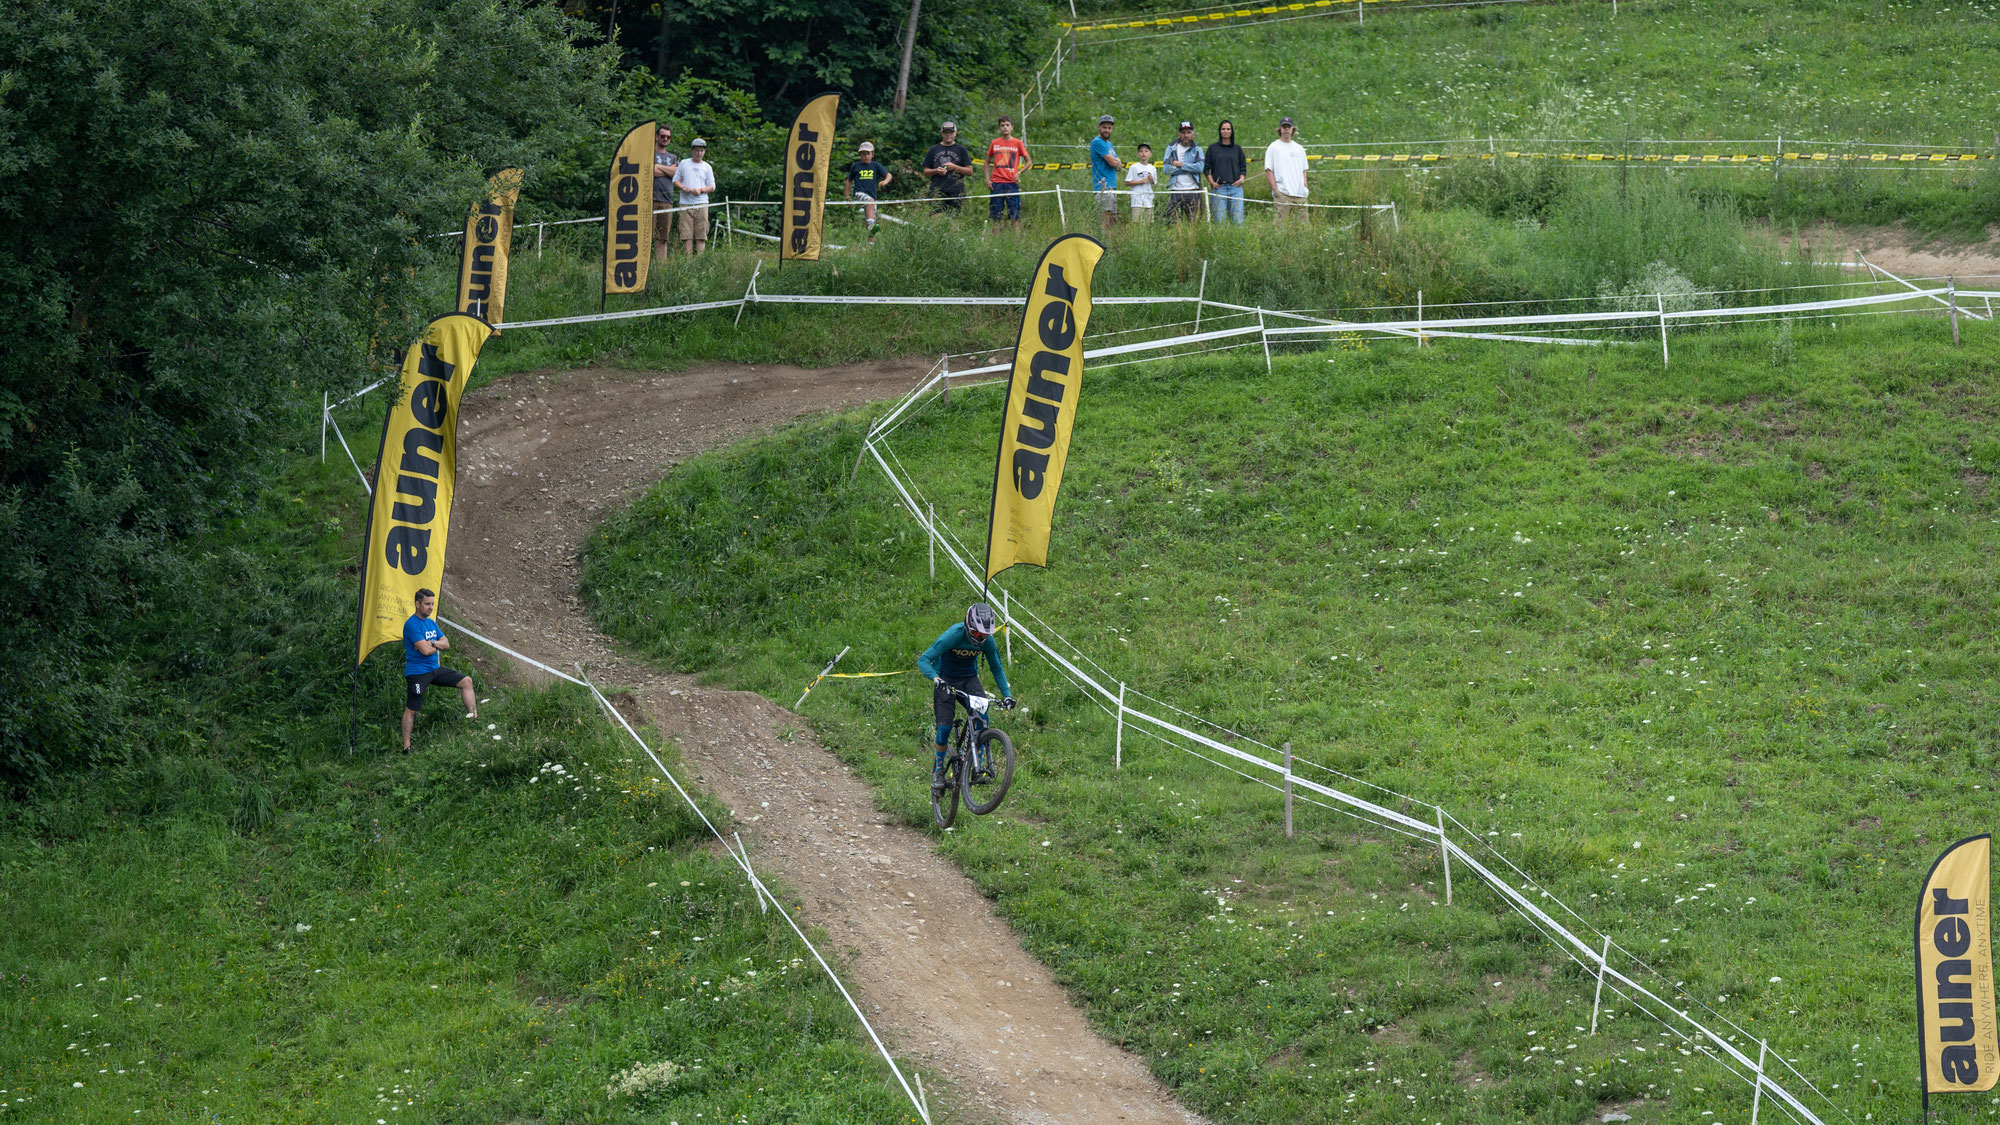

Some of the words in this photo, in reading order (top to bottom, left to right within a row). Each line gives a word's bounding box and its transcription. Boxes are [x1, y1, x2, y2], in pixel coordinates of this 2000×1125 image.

[614, 156, 640, 288] auner
[792, 122, 819, 254] auner
[859, 169, 874, 177] 122
[1012, 262, 1080, 500] auner
[385, 342, 456, 575] auner
[378, 593, 415, 607] ANYWHER
[1932, 888, 1978, 1086] auner
[1975, 898, 1987, 957] ANYTIME
[1983, 1044, 1995, 1074] RIDE
